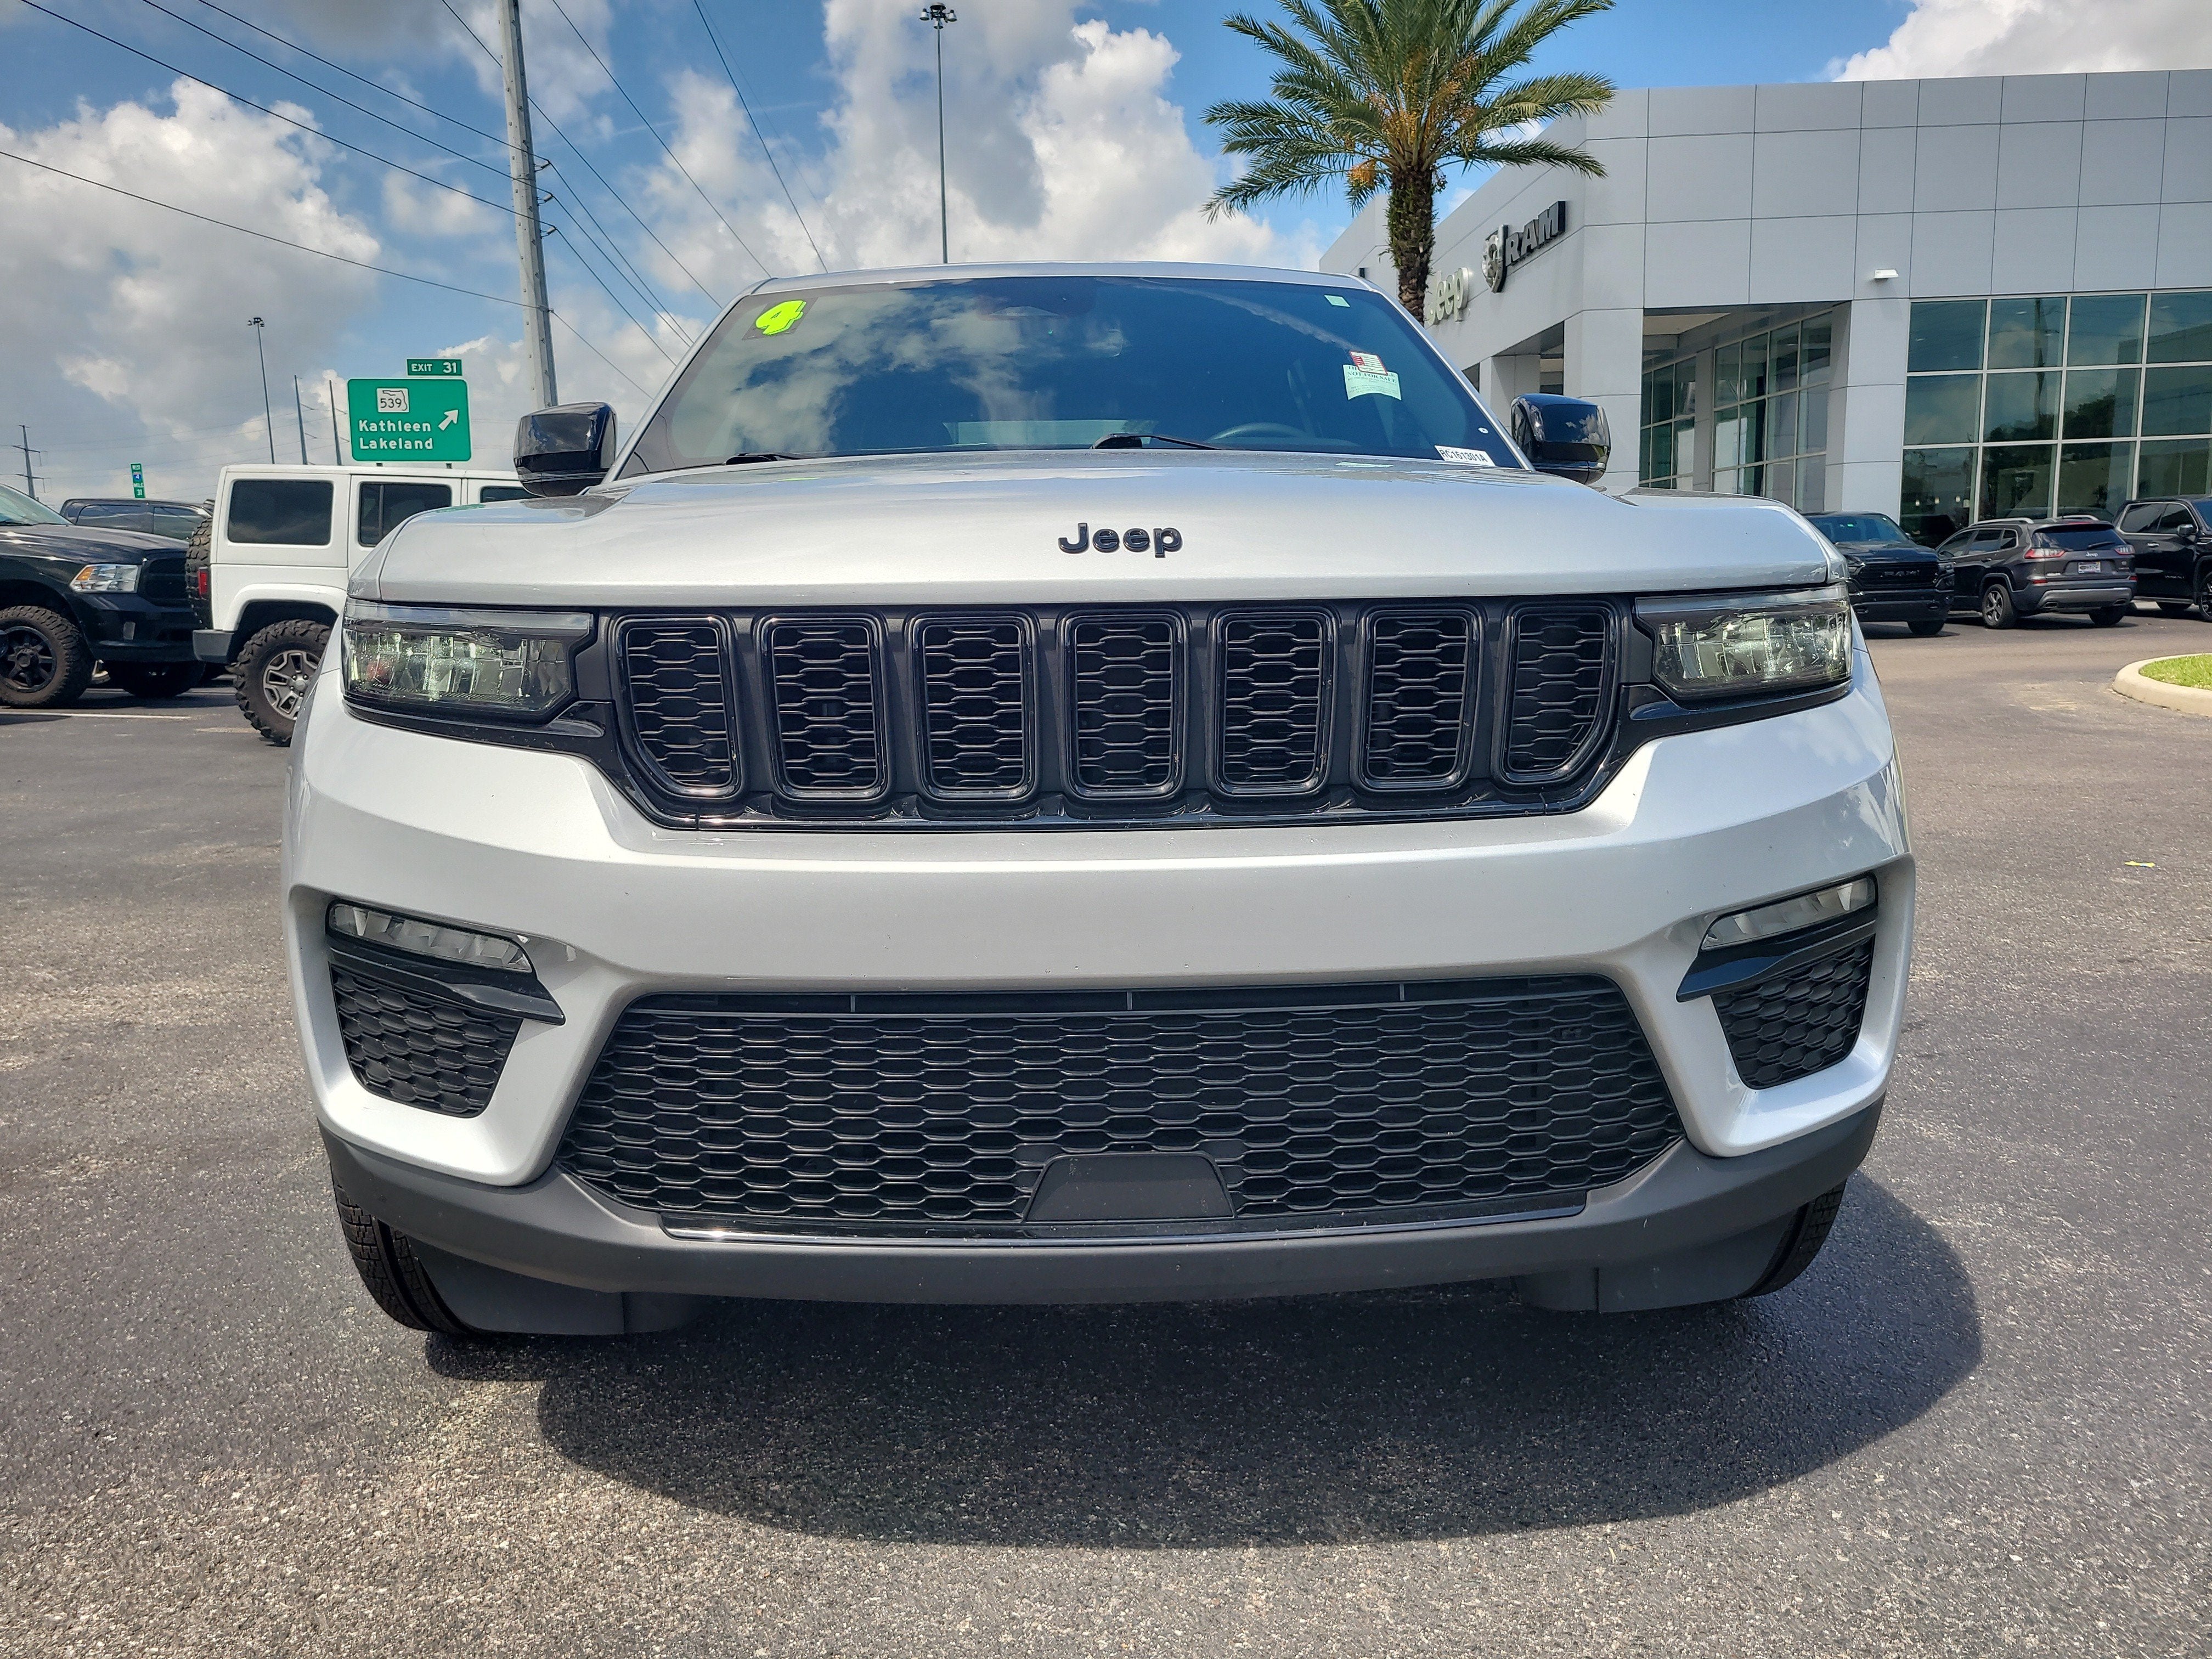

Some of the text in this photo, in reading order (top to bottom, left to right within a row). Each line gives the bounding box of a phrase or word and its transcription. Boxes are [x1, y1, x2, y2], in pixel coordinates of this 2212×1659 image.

[1505, 201, 1566, 267] RAM
[1424, 267, 1469, 326] Jeep
[755, 300, 806, 336] 4
[411, 362, 457, 373] EXIT 31
[380, 398, 402, 408] 539
[359, 420, 431, 432] Kathleen
[359, 437, 433, 449] Lakeland
[1438, 449, 1488, 462] RC161301A
[1058, 522, 1183, 558] Jeep
